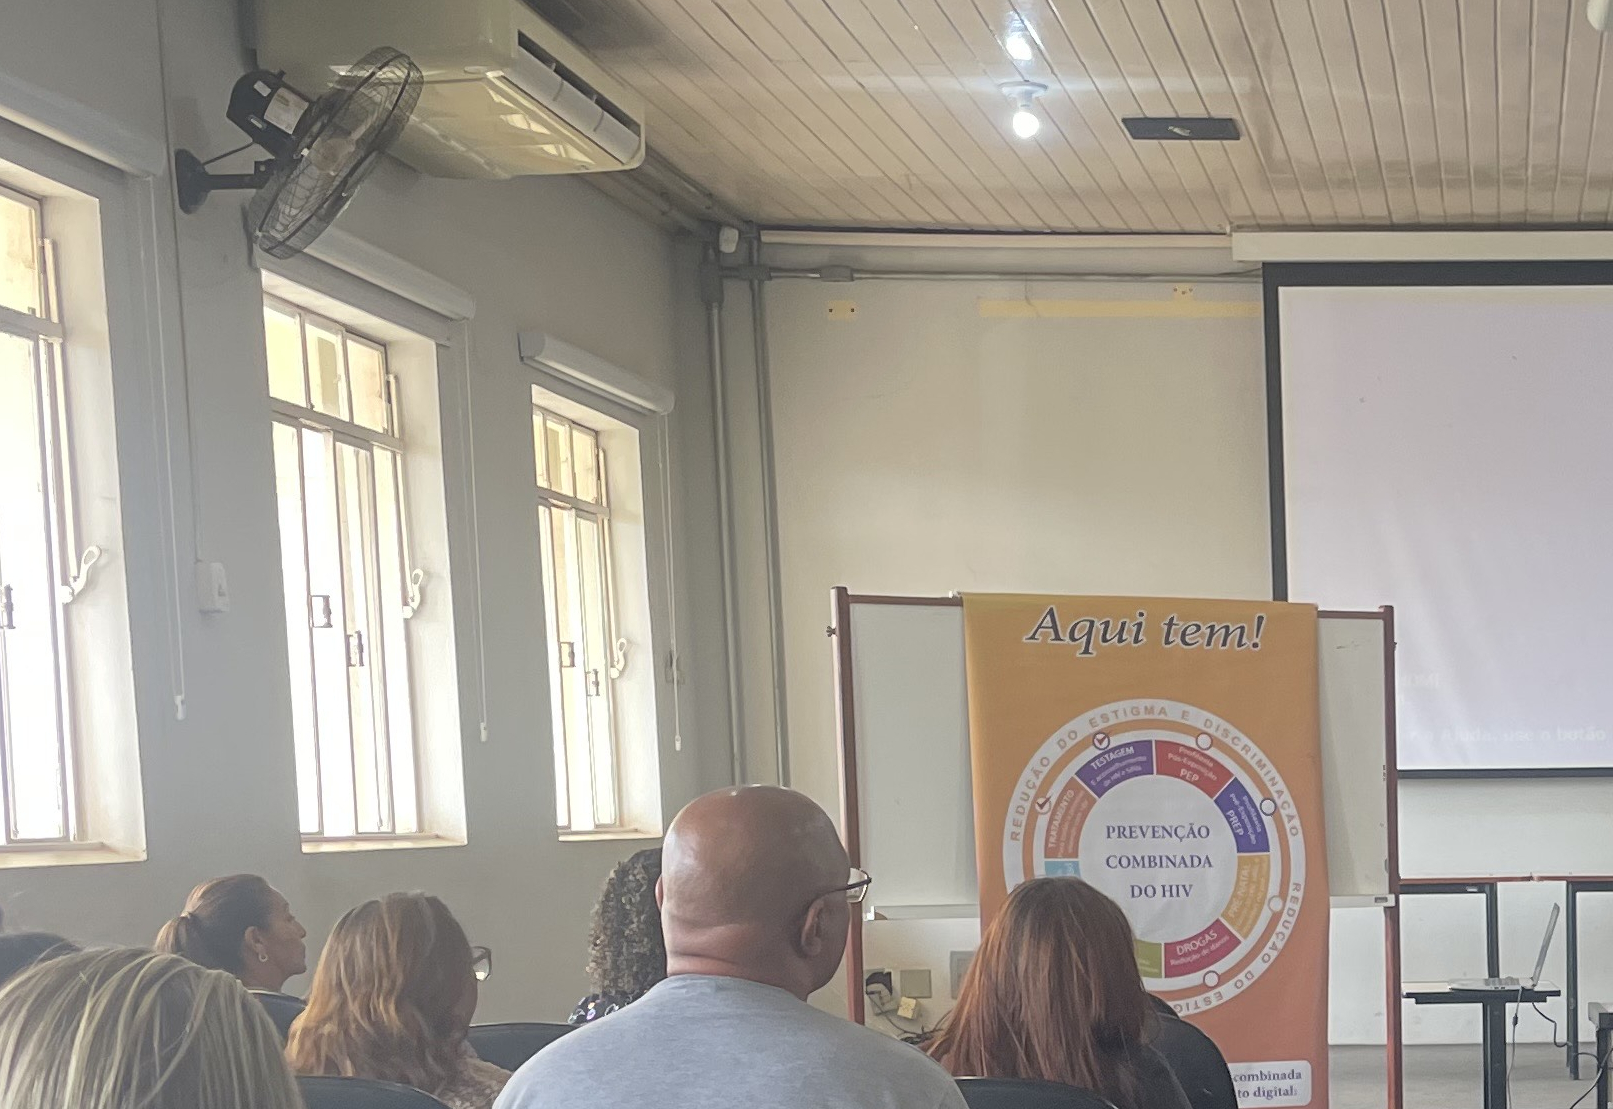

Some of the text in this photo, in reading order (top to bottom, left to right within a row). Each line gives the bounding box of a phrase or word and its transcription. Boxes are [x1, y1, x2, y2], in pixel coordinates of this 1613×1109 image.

[1023, 605, 1266, 657] Aqui tem!
[1090, 746, 1135, 770] TESTAGEM
[1010, 756, 1050, 842] REDUÇÃO
[1056, 729, 1079, 750] DO
[1088, 705, 1169, 729] ESTIGMA
[1181, 710, 1191, 721] E
[1203, 718, 1300, 838] DISCRIMINAÇÃO
[1180, 768, 1200, 782] PEP
[1048, 789, 1075, 848] TRATAMENTO
[1226, 809, 1244, 836] PREP
[1106, 823, 1210, 842] PREVENÇÃO
[1106, 854, 1213, 869] COMBINADA
[1130, 884, 1193, 898] DO HIV
[1176, 929, 1218, 956] DROGAS
[1234, 970, 1255, 989] DO
[1173, 991, 1224, 1013] ESTIG
[1233, 1068, 1302, 1083] combinada
